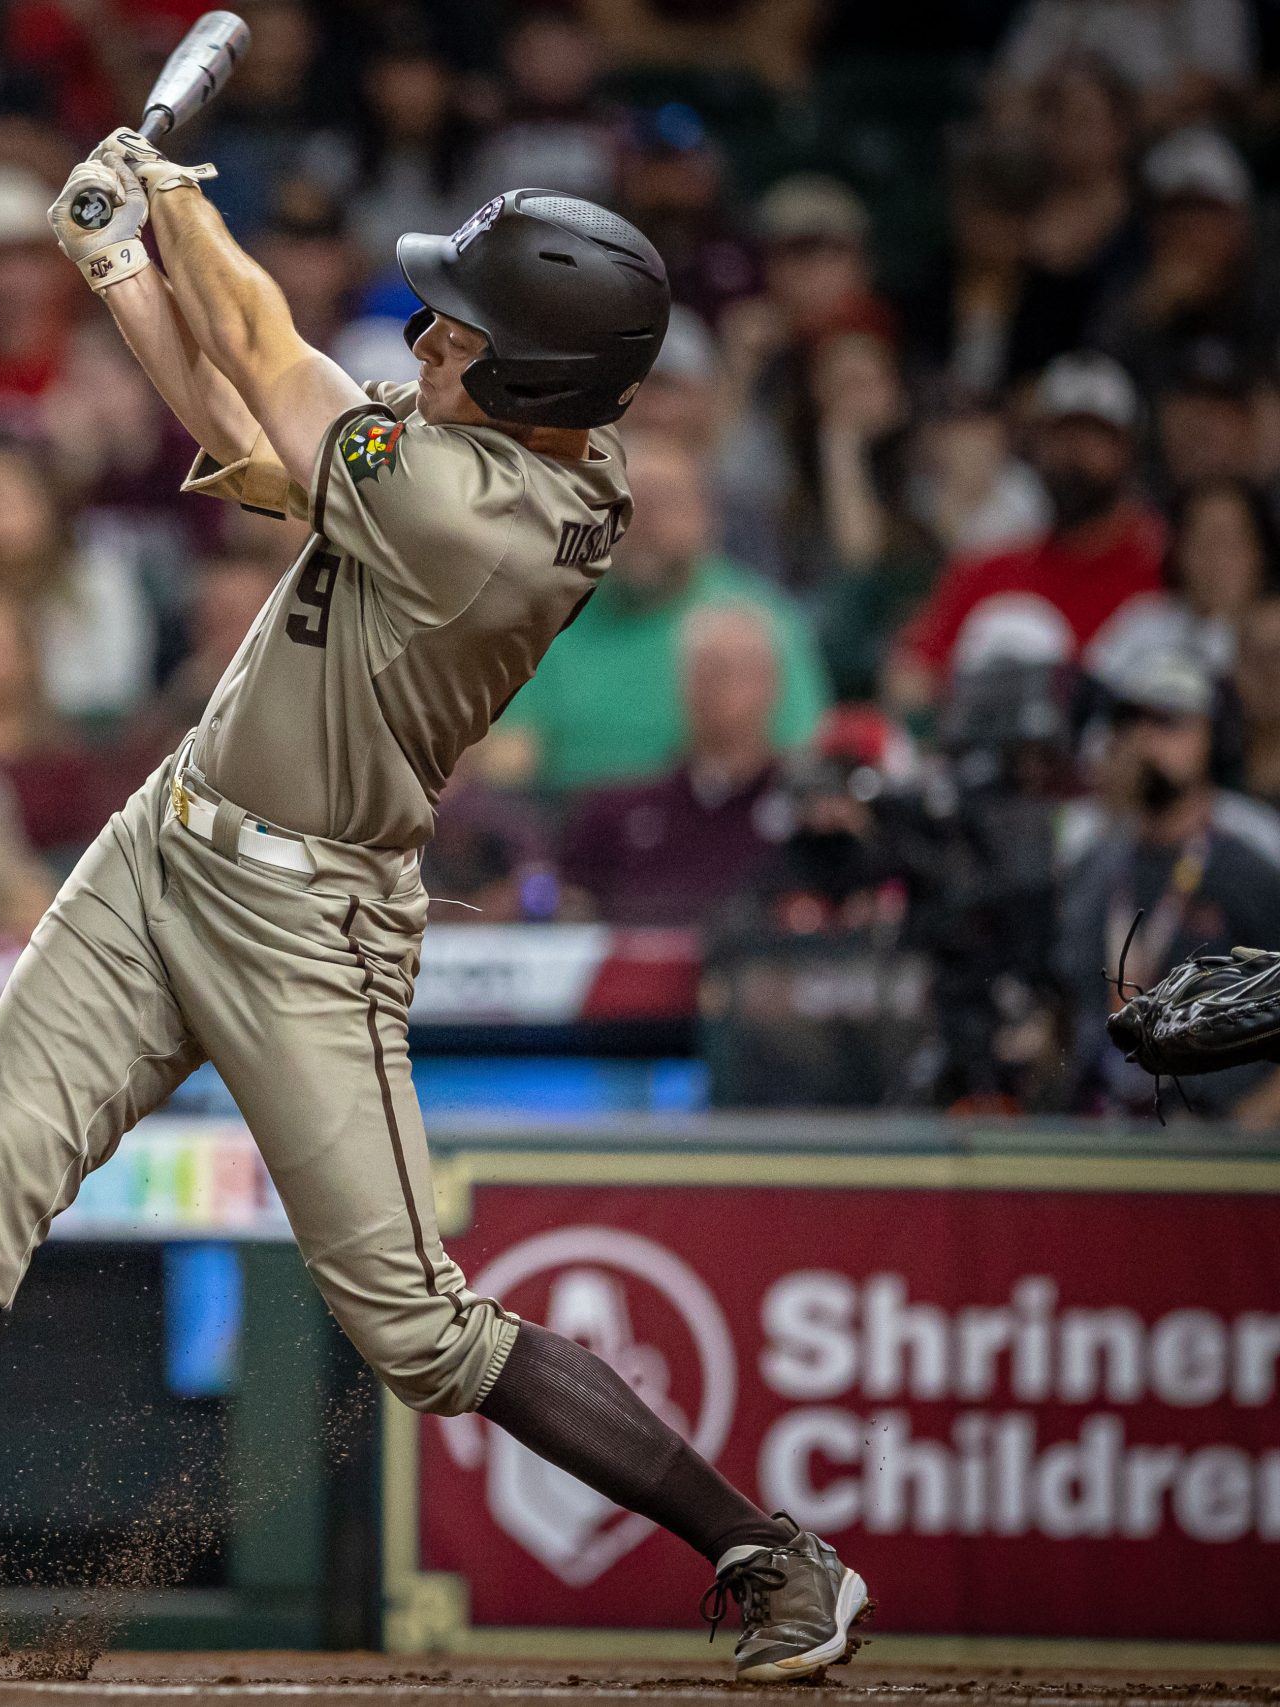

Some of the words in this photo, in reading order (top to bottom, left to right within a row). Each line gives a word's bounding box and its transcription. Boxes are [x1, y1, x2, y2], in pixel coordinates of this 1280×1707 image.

[120, 248, 131, 264] 9
[285, 549, 341, 649] 9
[756, 1405, 1280, 1545] Childre
